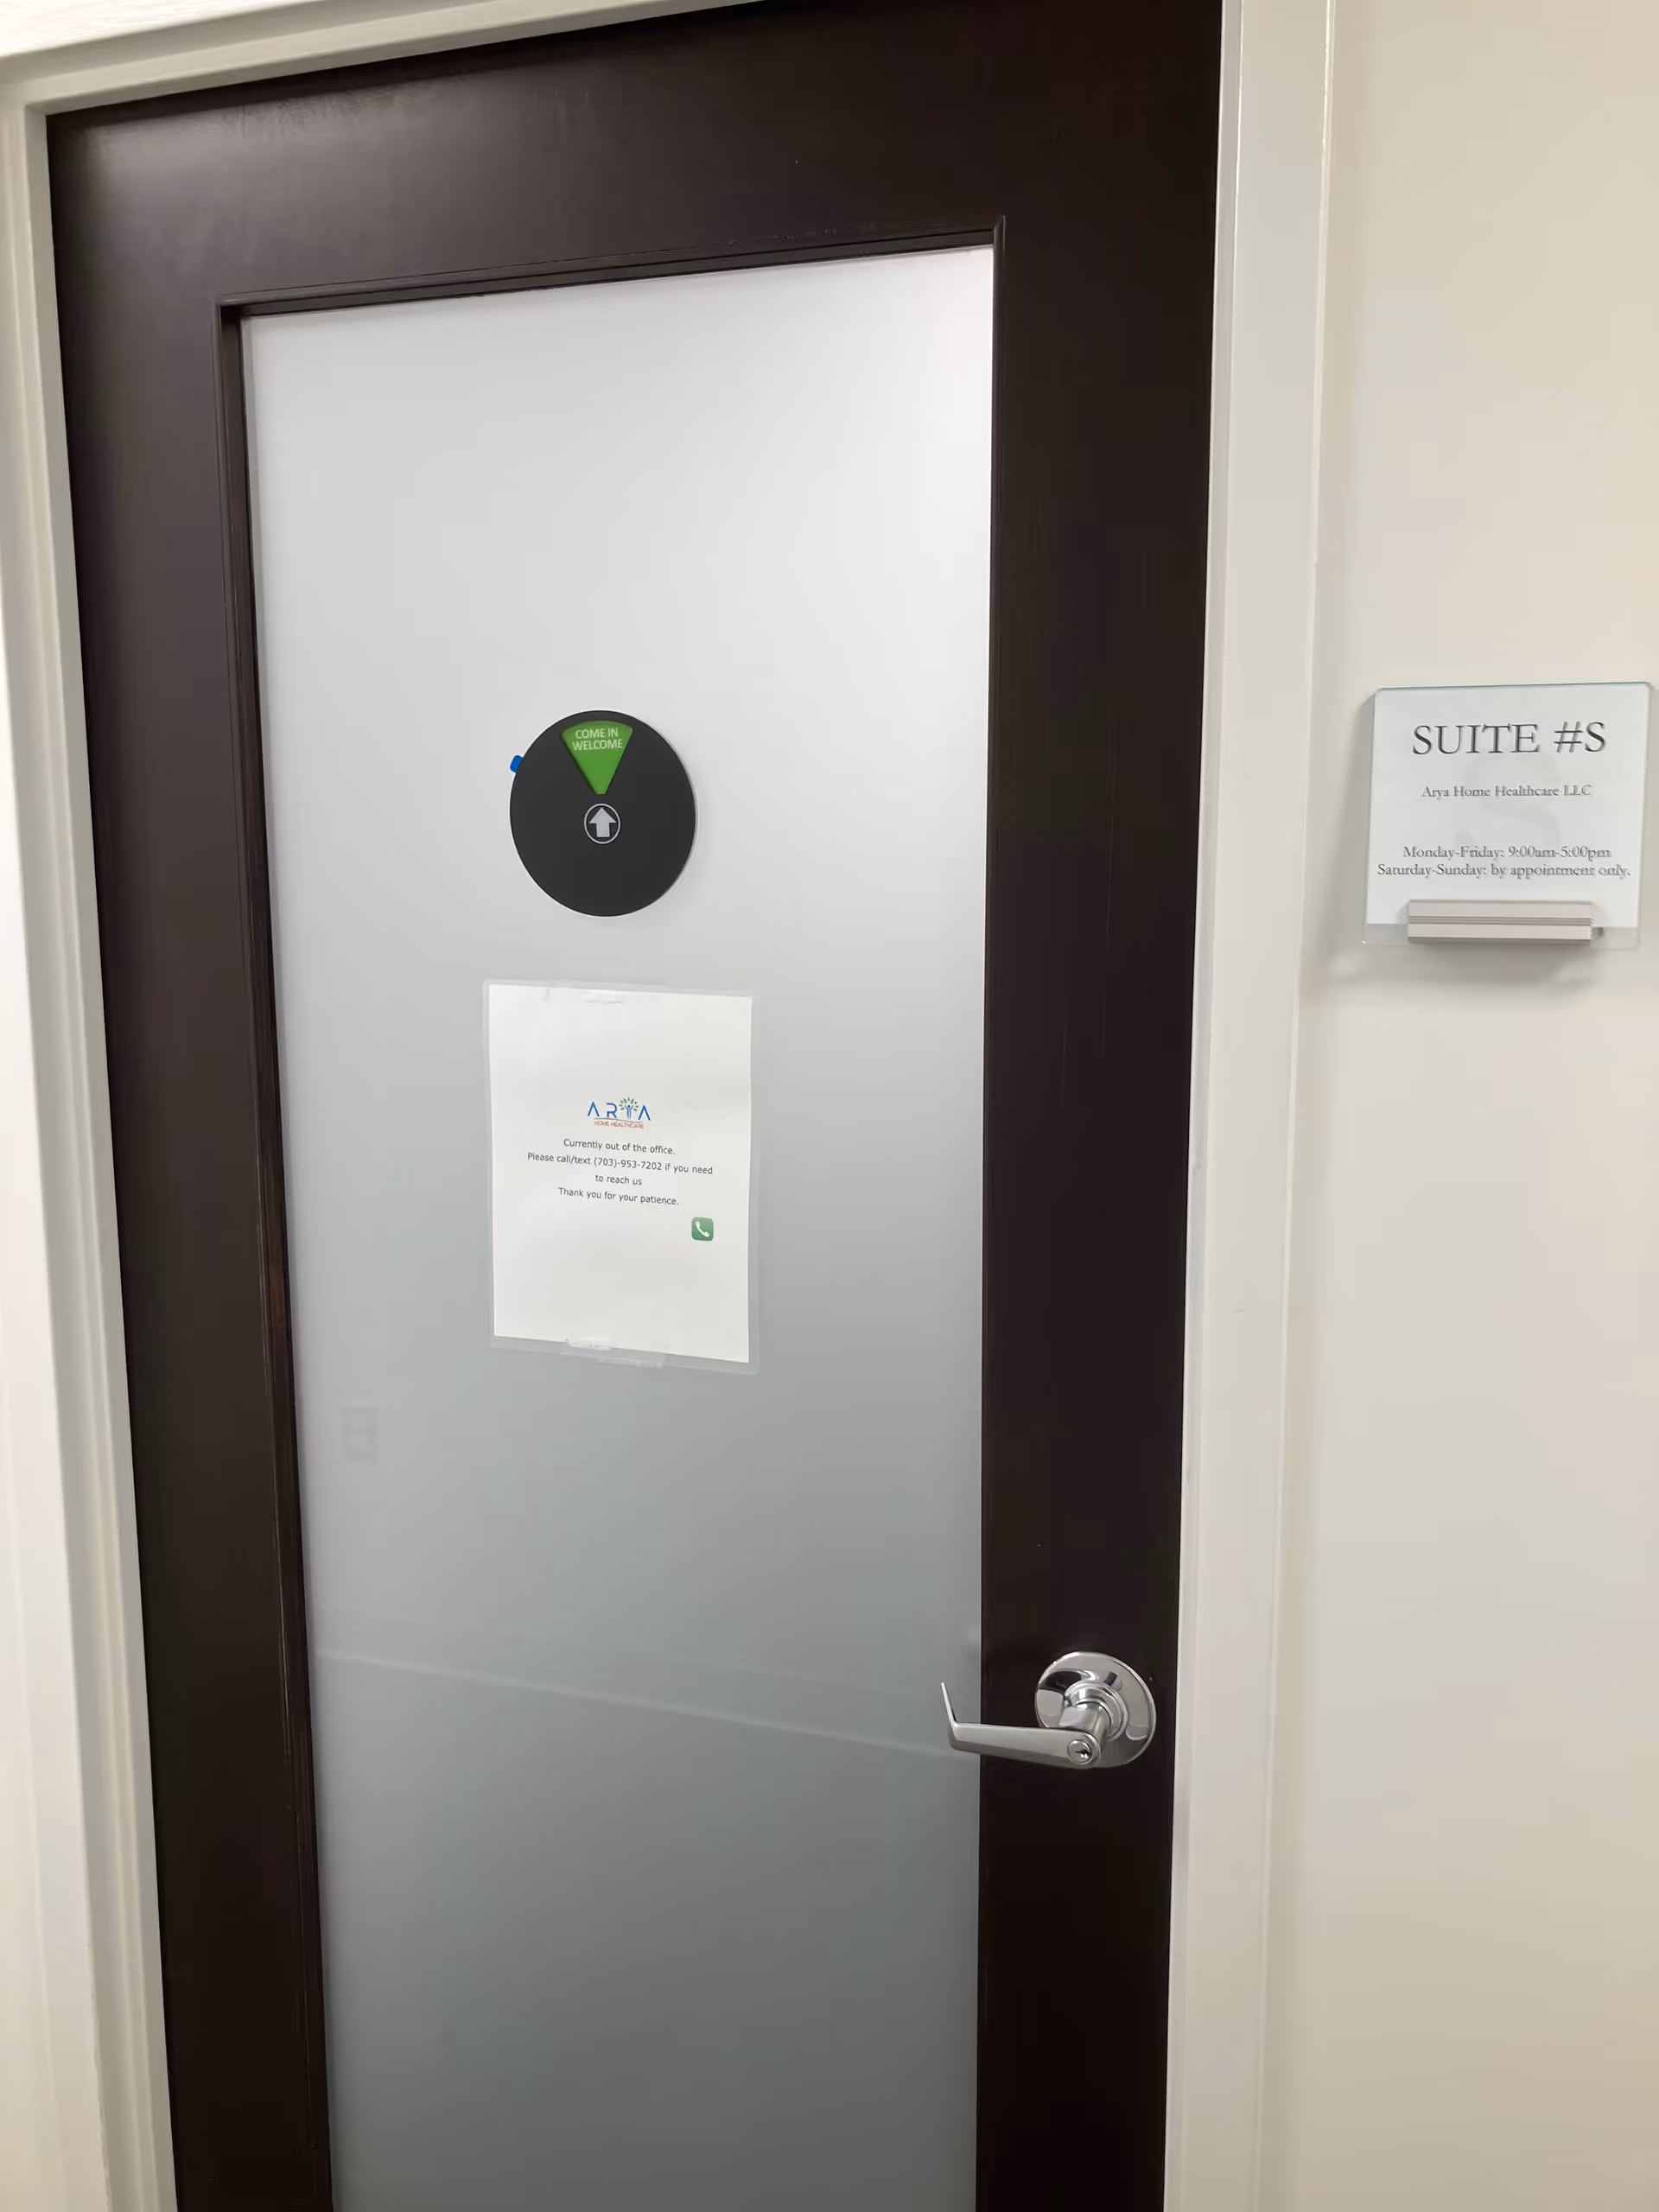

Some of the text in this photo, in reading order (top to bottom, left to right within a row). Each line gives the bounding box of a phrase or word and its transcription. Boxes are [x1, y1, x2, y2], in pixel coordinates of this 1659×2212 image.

[575, 728, 619, 739] COME IN
[1412, 721, 1605, 755] SUITE #S
[572, 739, 623, 751] WELCOME
[1421, 785, 1592, 799] Arya Home Healthcare LLC
[1403, 845, 1611, 861] Monday-Friday: 9:00am-5:00pm
[1377, 863, 1631, 878] Saturday-Sunday: by appointment only.
[588, 1097, 651, 1121] ARYA
[563, 1139, 602, 1150] Currently
[606, 1142, 620, 1151] out
[632, 1144, 646, 1153] the
[650, 1145, 676, 1154] office.
[527, 1152, 713, 1175] Please call/text (703)-953-7202 if you need
[607, 1175, 630, 1185] reach
[558, 1187, 679, 1205] Thank you for your patience.
